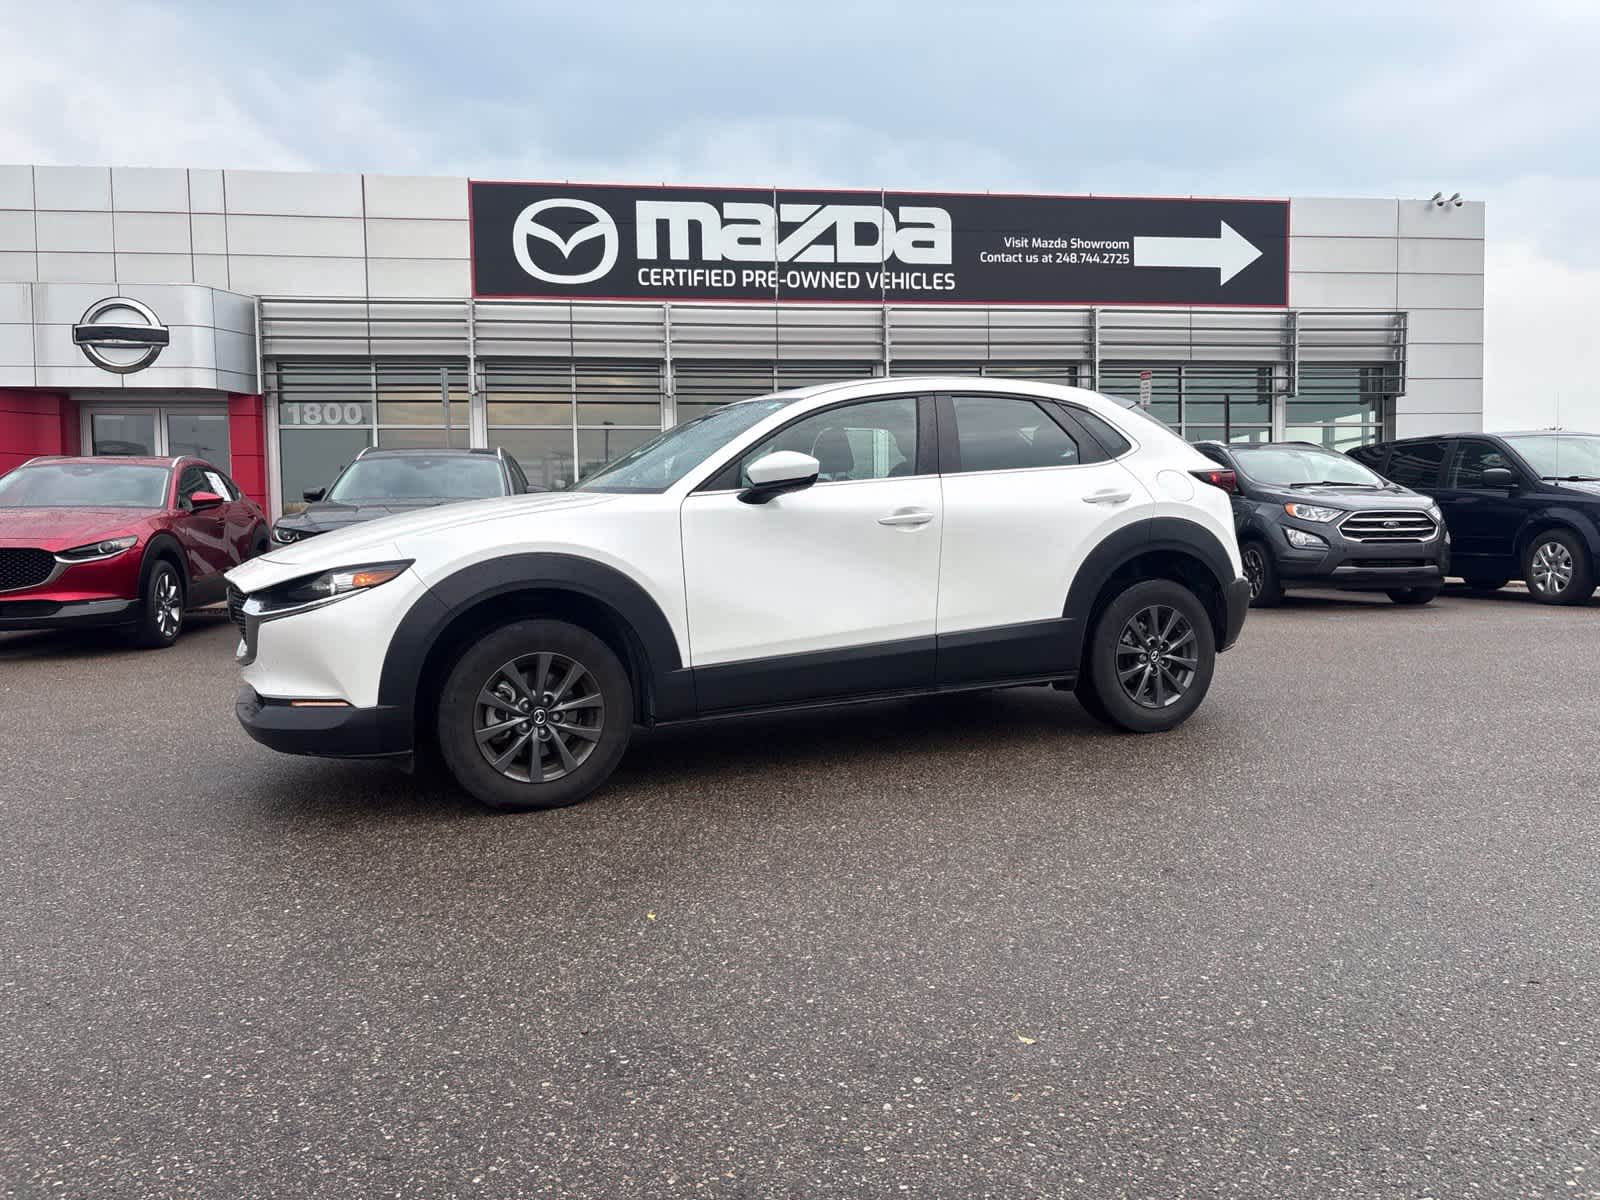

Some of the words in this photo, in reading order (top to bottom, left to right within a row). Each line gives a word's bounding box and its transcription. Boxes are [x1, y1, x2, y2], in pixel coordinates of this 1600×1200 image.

[1003, 236, 1029, 249] Visit
[1032, 237, 1068, 249] Mazda
[1070, 237, 1130, 250] Showroom
[979, 251, 1022, 263] Contact
[1025, 253, 1039, 263] us
[1041, 252, 1053, 263] at
[1055, 252, 1130, 265] 248.744.2725
[637, 267, 736, 288] CERTIFIED
[742, 269, 860, 290] PRE-OWNED
[865, 270, 956, 291] VEHICLES
[287, 402, 362, 425] 1800
